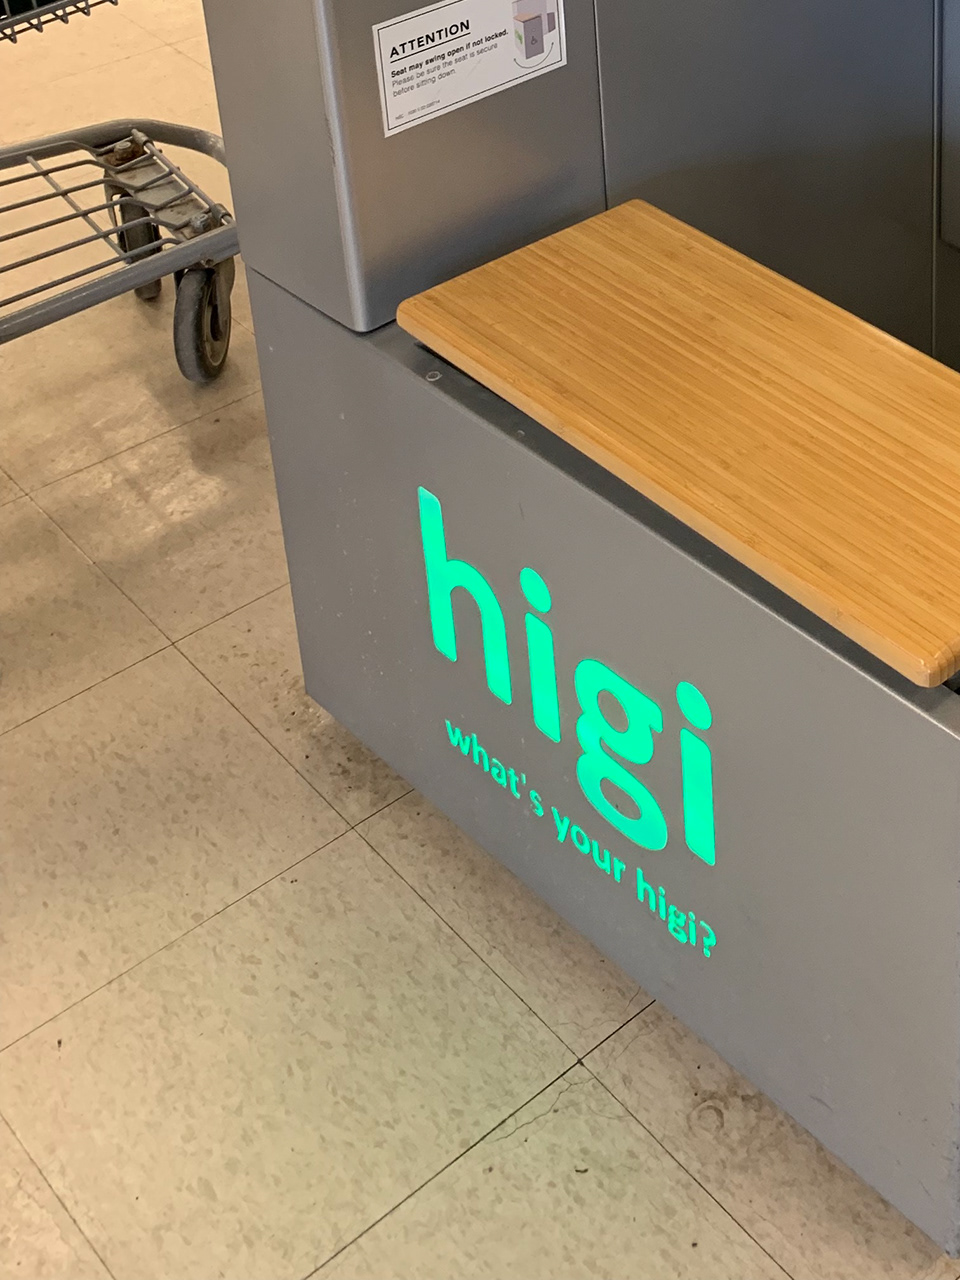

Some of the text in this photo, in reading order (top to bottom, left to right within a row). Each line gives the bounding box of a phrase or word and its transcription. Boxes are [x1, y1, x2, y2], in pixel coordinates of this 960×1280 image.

[390, 19, 470, 58] ATTENTION
[391, 28, 508, 78] Seat may swing open if not locked.
[392, 74, 414, 87] Please
[416, 70, 425, 79] be
[426, 64, 441, 74] sure
[442, 60, 453, 68] the
[454, 53, 468, 64] seat
[476, 43, 498, 56] secure
[393, 85, 414, 97] before
[416, 76, 437, 89] sitting
[418, 486, 717, 866] higi
[445, 719, 718, 958] what's your higi?
